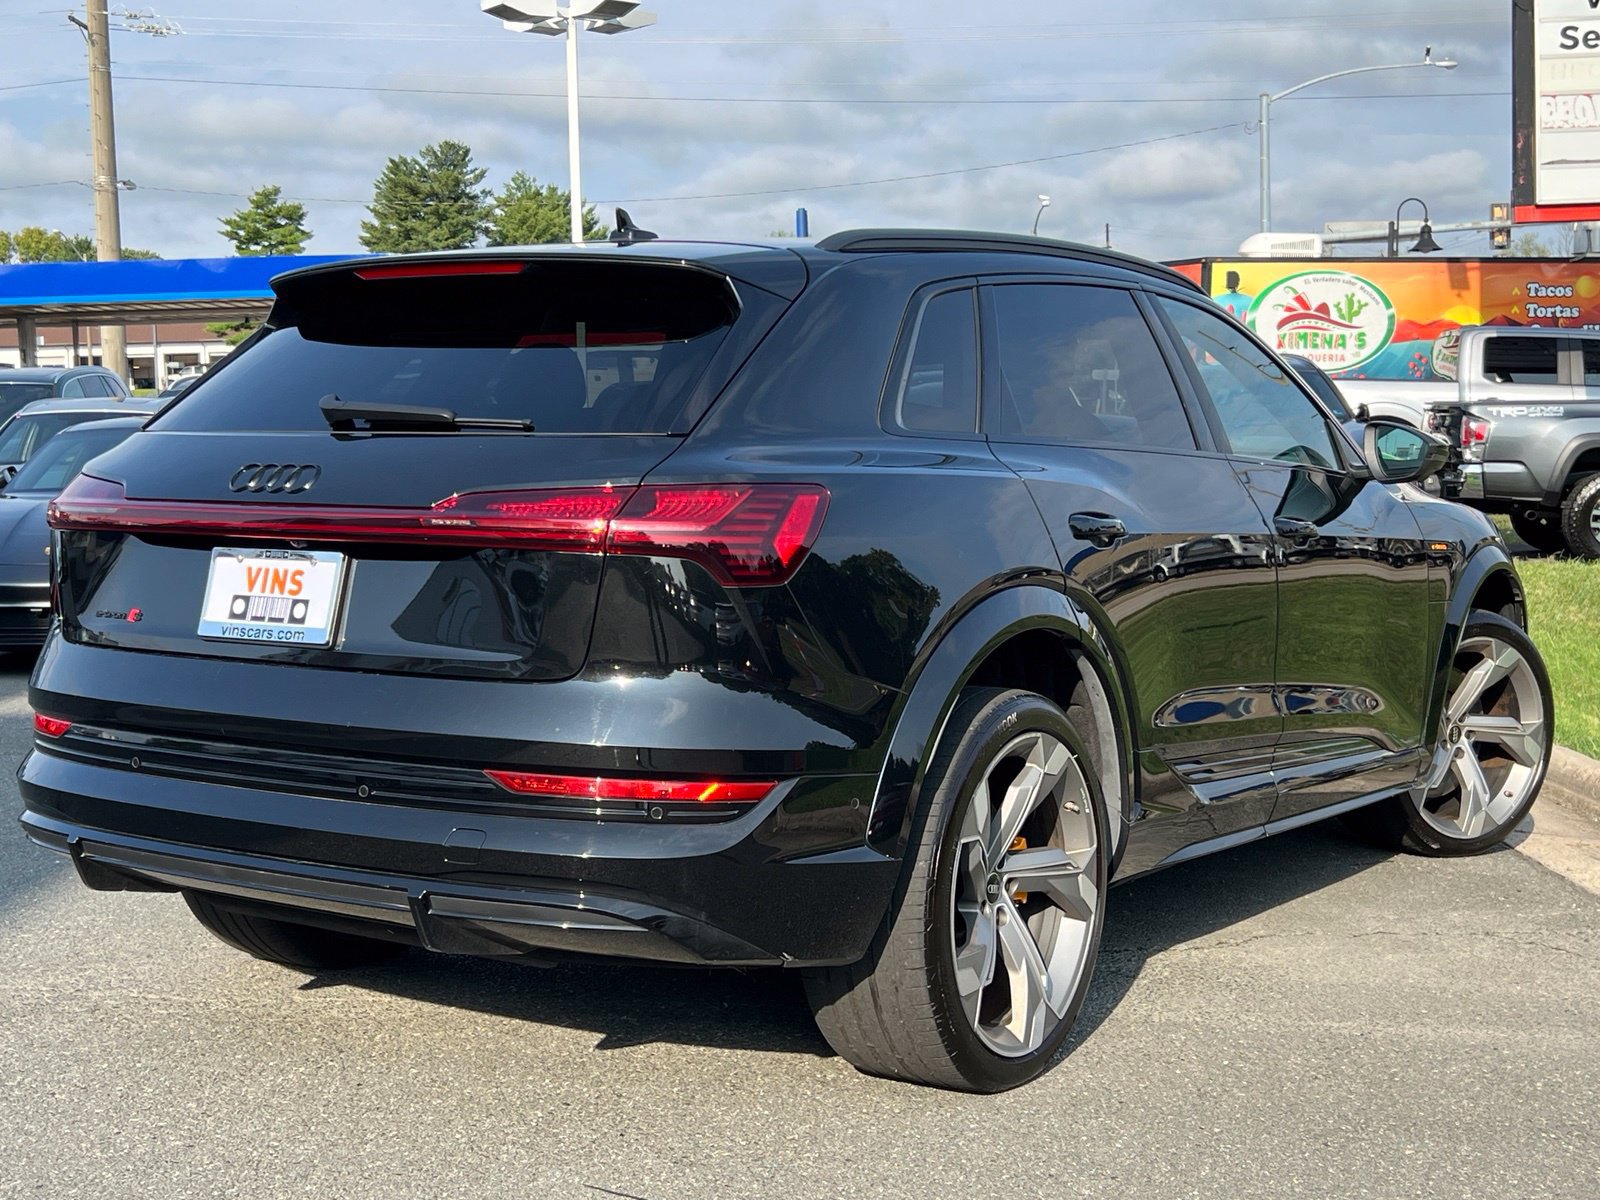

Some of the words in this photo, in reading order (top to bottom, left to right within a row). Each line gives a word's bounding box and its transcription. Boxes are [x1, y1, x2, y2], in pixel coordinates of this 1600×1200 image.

[1527, 283, 1573, 297] Tacos
[1526, 303, 1580, 318] Tortas
[1277, 331, 1367, 350] XIMENA'S
[1307, 353, 1346, 362] QUERIA
[246, 566, 305, 596] VINS
[221, 624, 305, 641] vinscars.com
